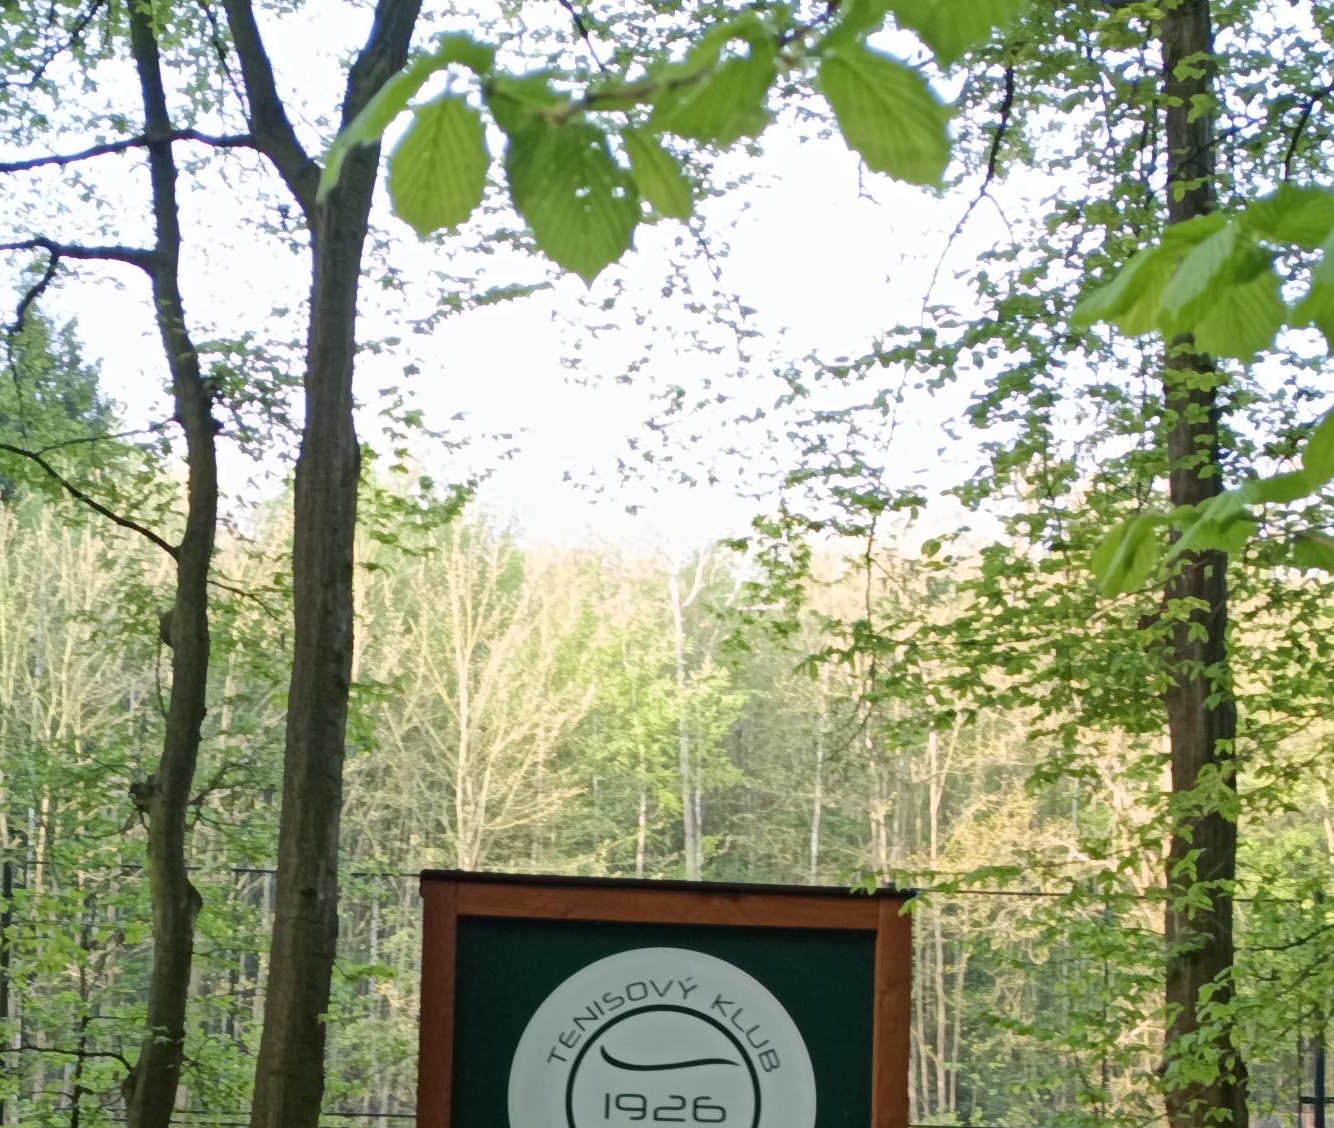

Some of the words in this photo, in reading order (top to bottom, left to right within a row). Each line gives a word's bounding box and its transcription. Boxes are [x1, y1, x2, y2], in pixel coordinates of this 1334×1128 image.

[547, 977, 698, 1064] TENISOVÝ
[711, 994, 780, 1073] KLUB
[604, 1092, 727, 1123] 1926
